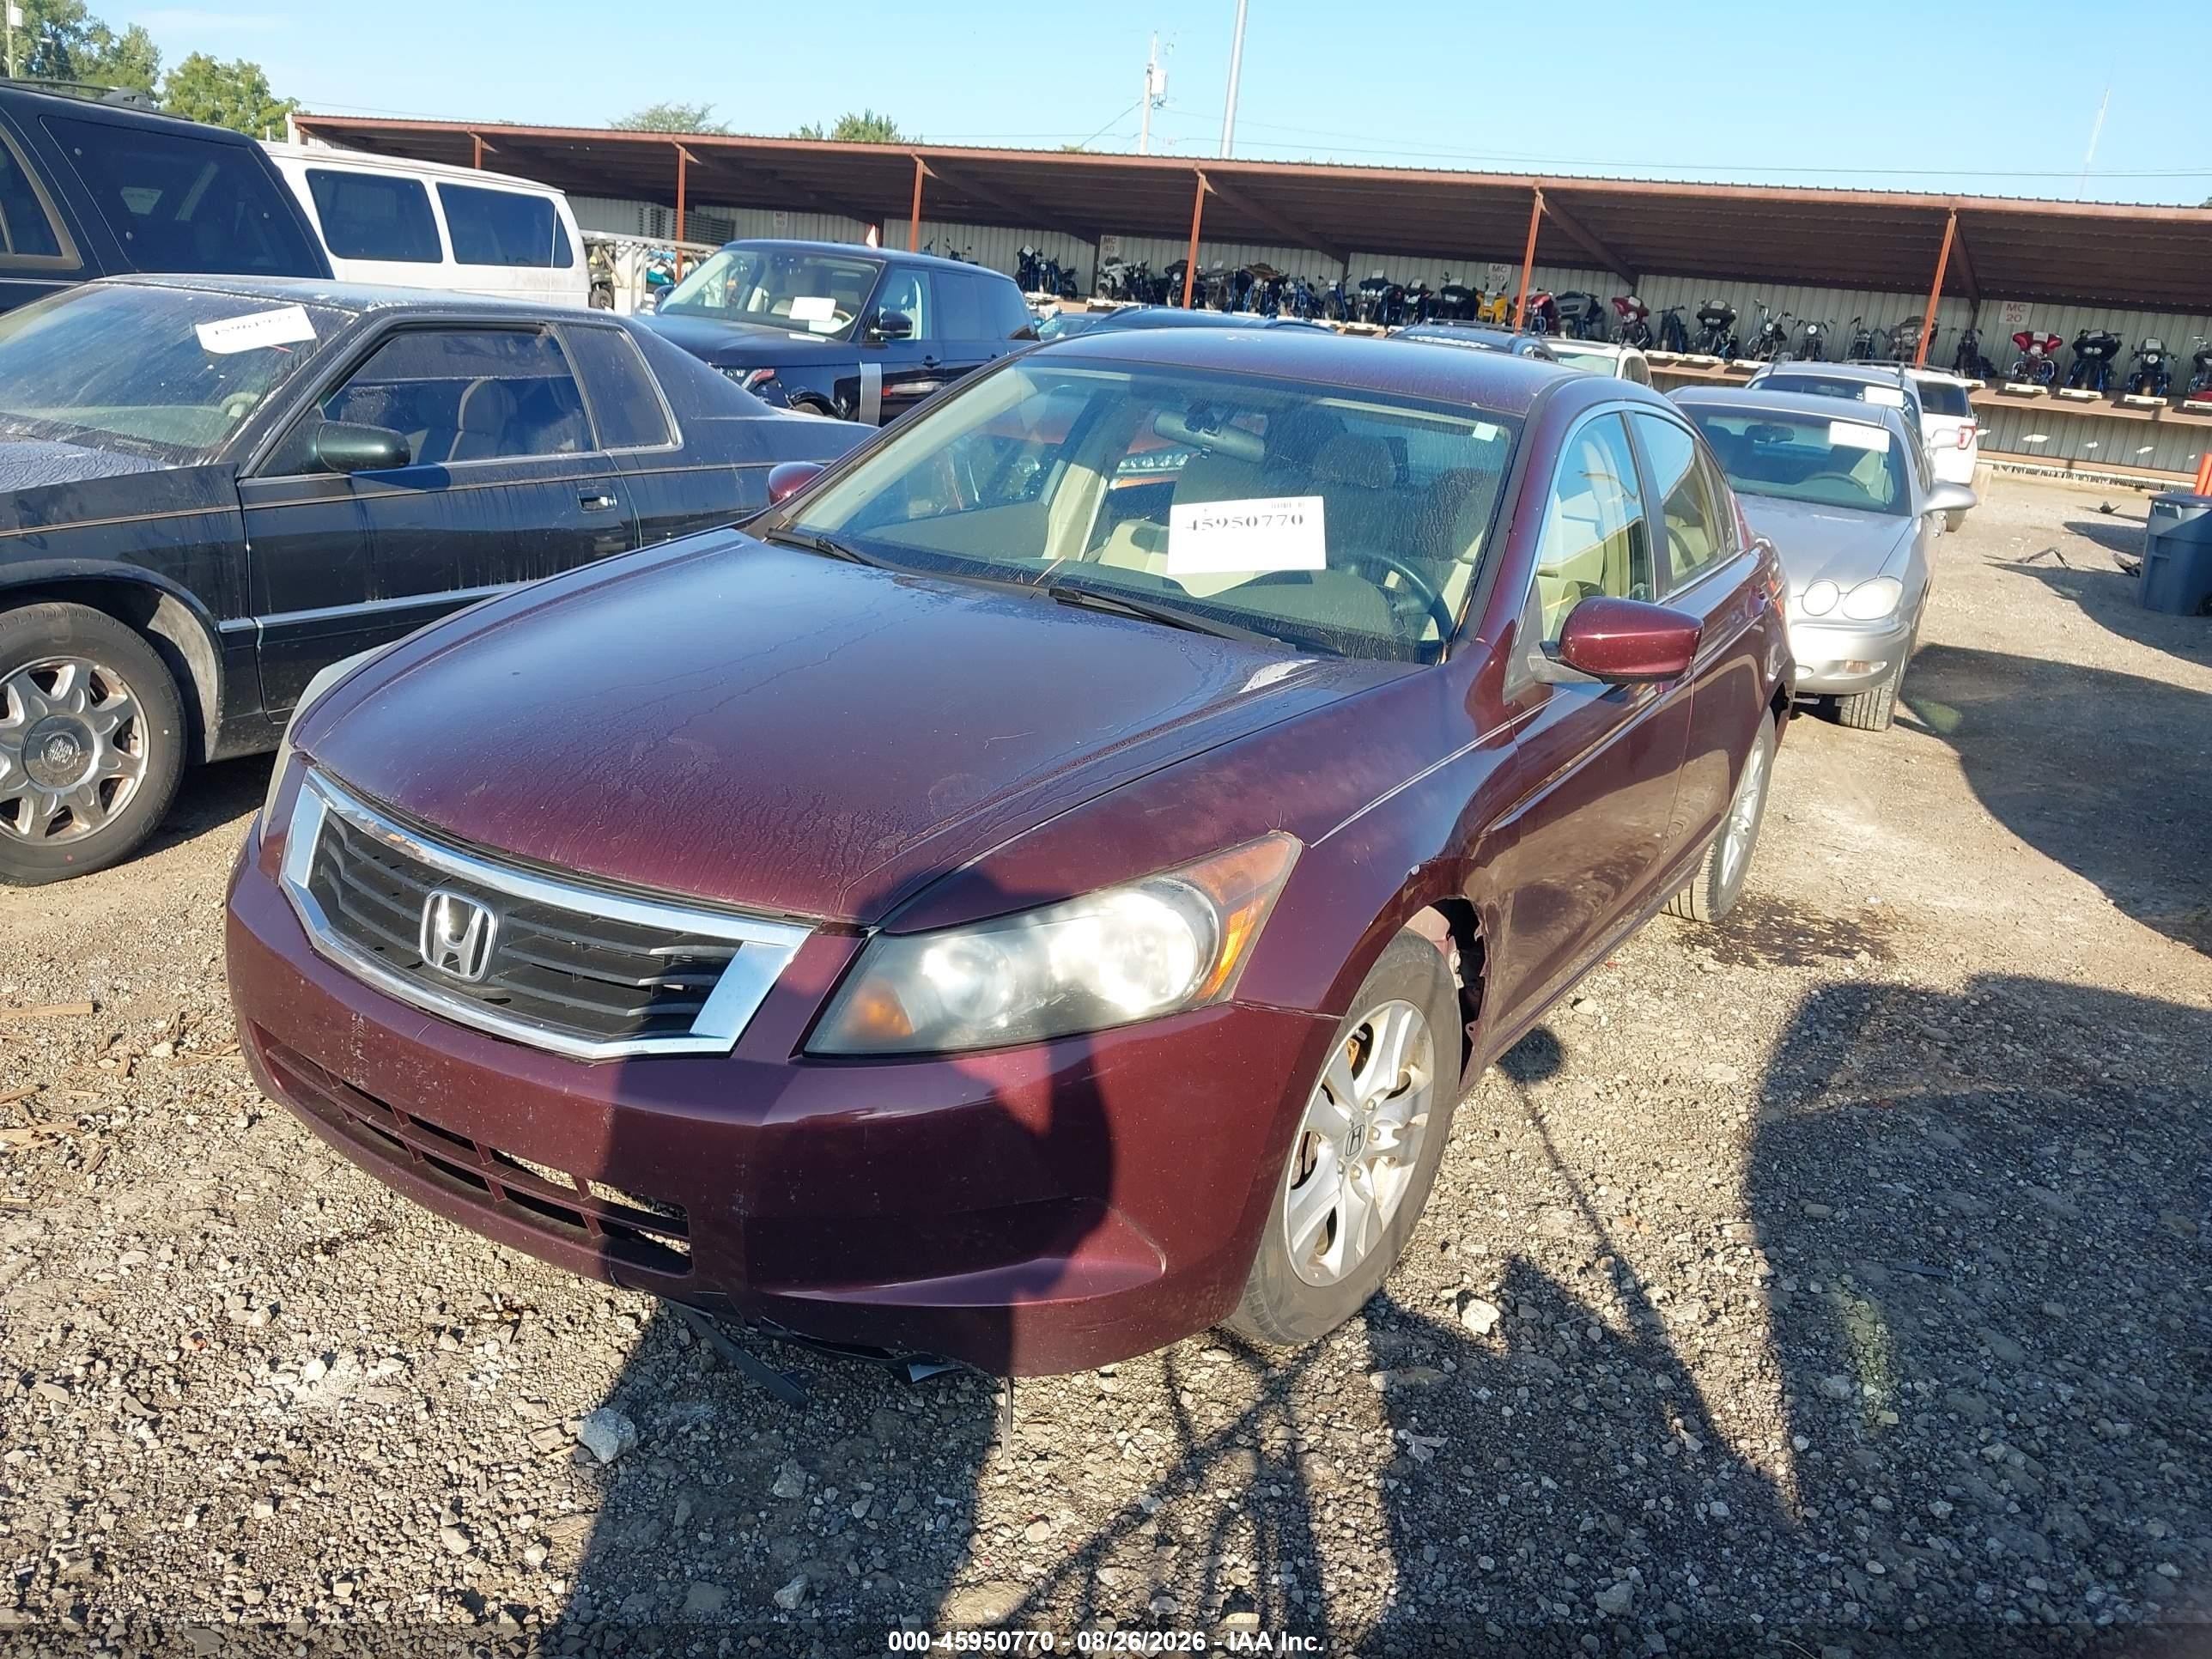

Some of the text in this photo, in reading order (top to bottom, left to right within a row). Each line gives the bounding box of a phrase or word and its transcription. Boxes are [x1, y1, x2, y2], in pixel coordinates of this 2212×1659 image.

[1492, 264, 1507, 273] MC
[2006, 303, 2027, 312] MC
[2006, 313, 2022, 323] 20
[1185, 514, 1304, 531] 45950770
